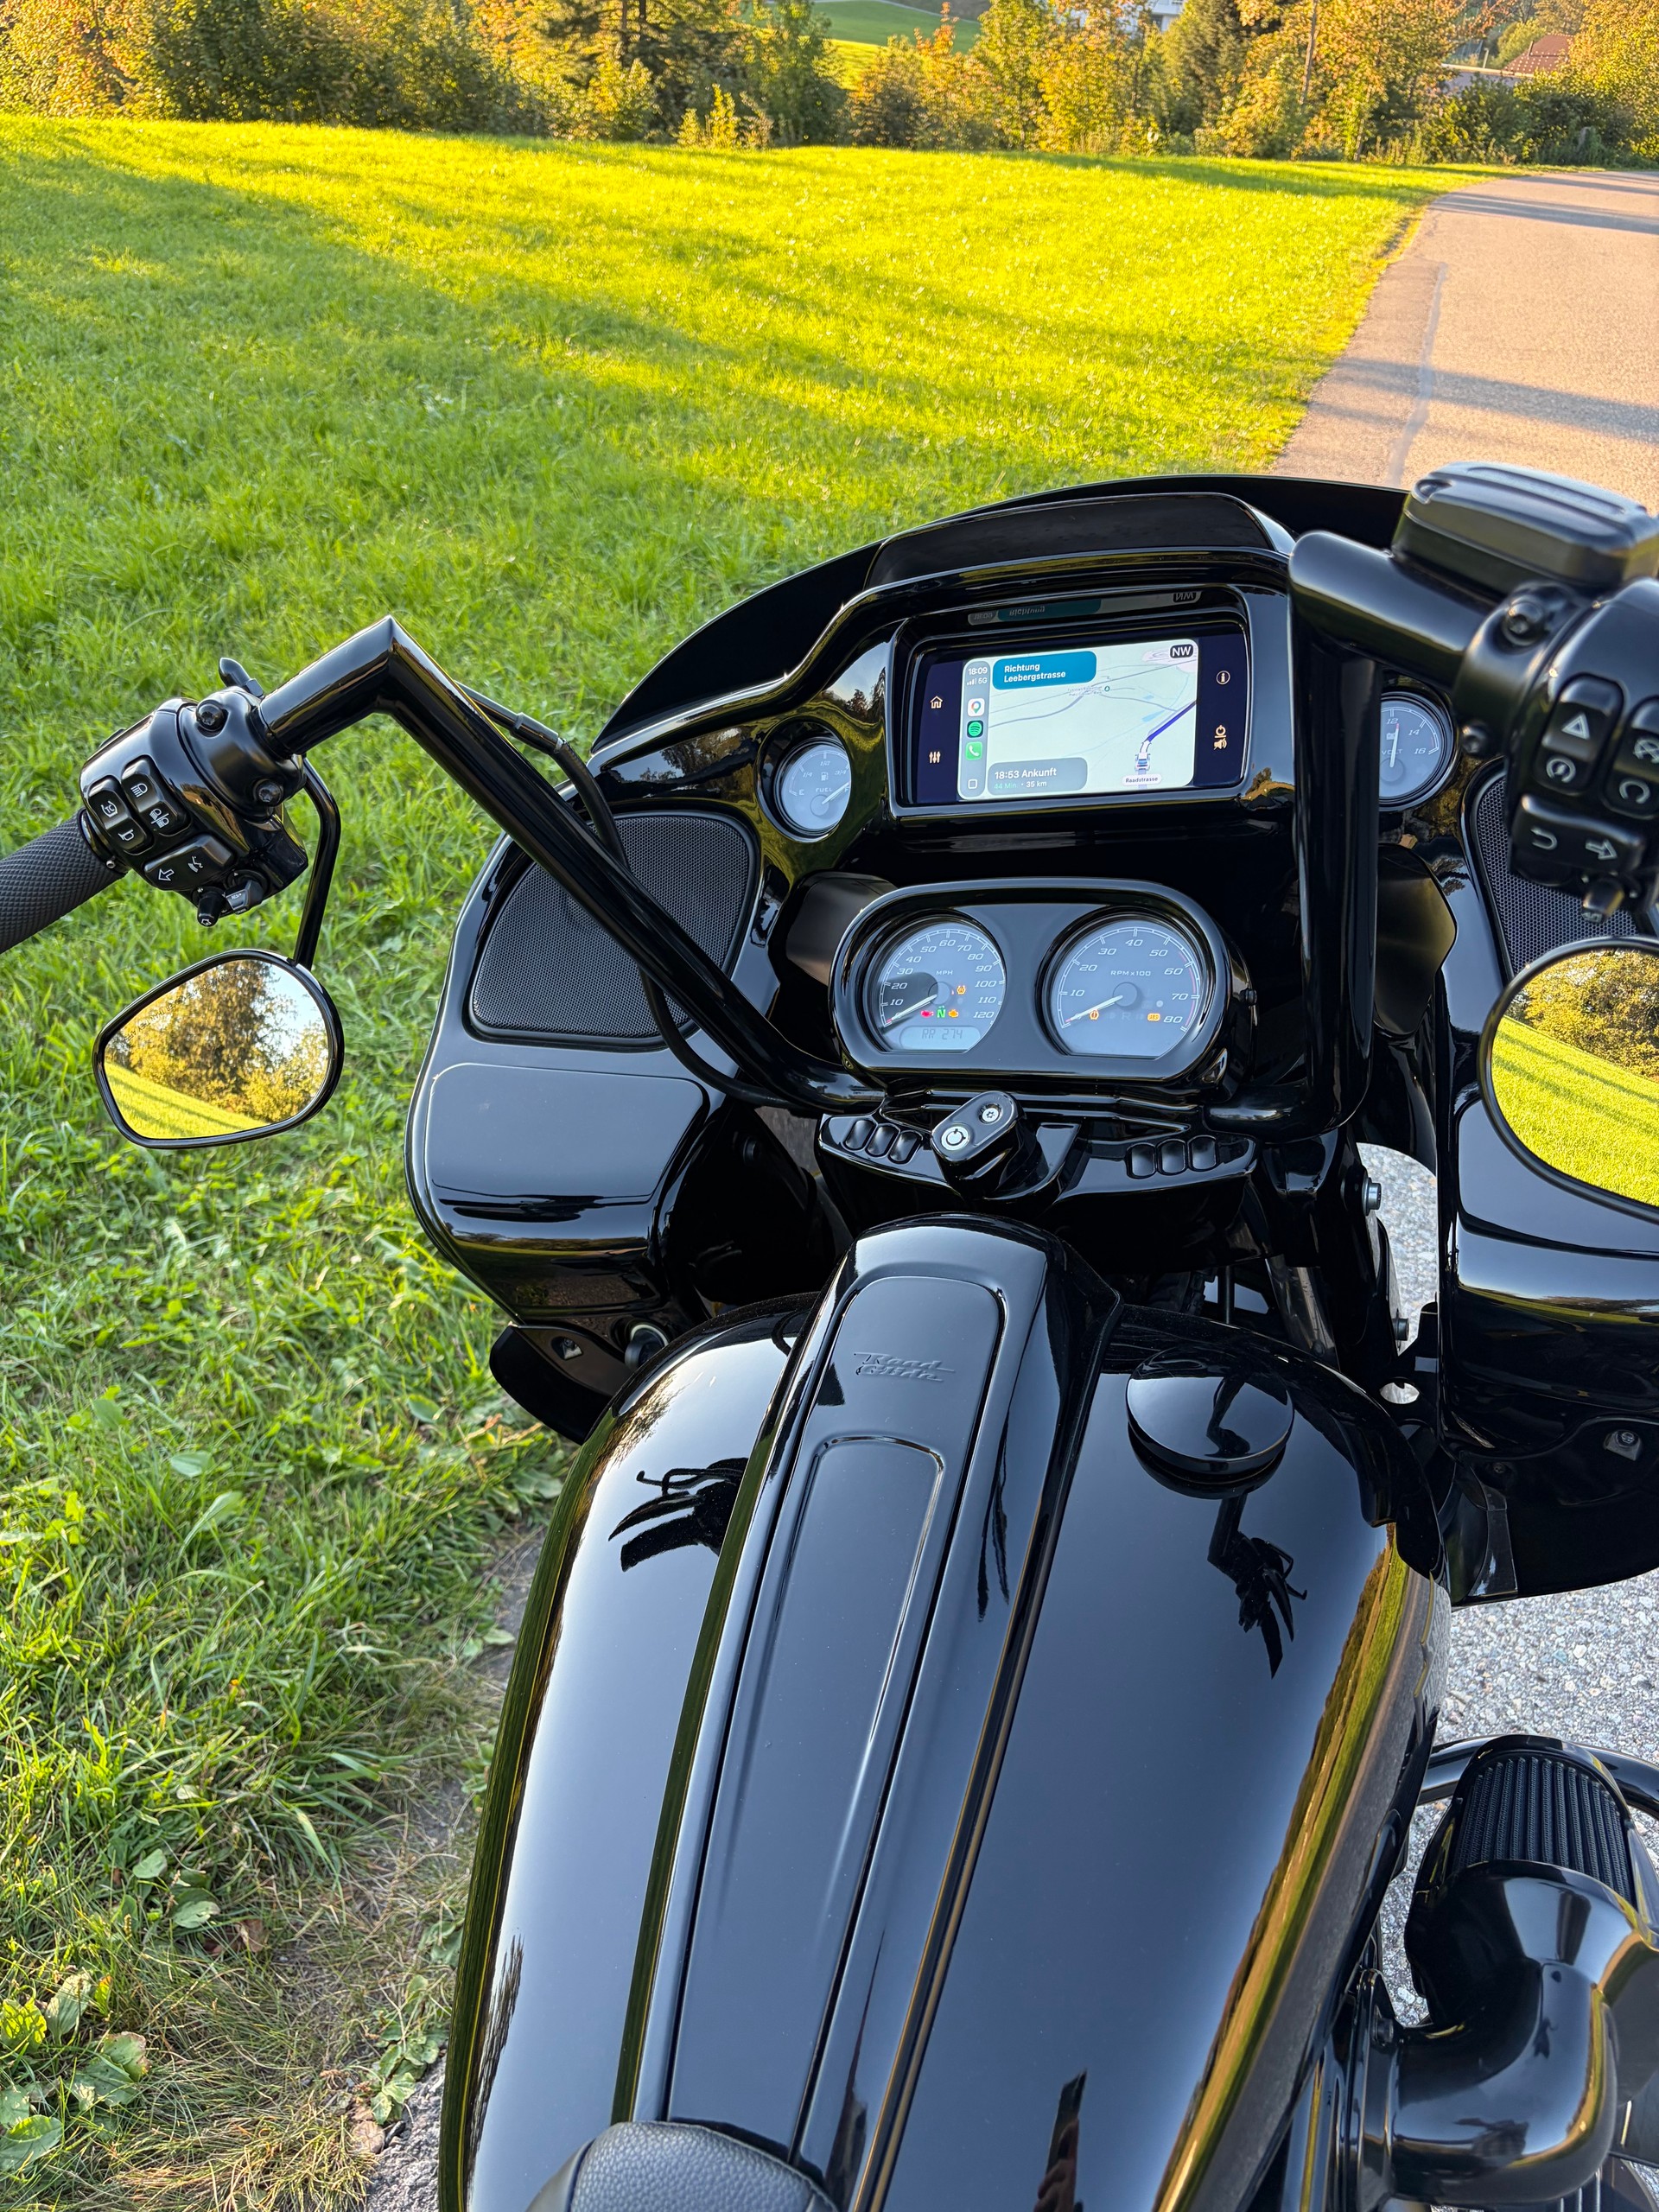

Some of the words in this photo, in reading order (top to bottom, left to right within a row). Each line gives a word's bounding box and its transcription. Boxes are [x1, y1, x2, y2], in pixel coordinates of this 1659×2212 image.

[1172, 645, 1192, 657] NW
[968, 666, 988, 676] 18:09
[1004, 664, 1040, 673] Richtung
[1004, 671, 1066, 683] Leebergstrasse
[995, 770, 1020, 779] 18:53
[1021, 767, 1057, 778] Ankunft
[1125, 938, 1143, 947] 40
[1149, 949, 1168, 957] 50
[1164, 967, 1184, 976] 60
[937, 1009, 946, 1018] N
[1163, 1015, 1183, 1024] 80
